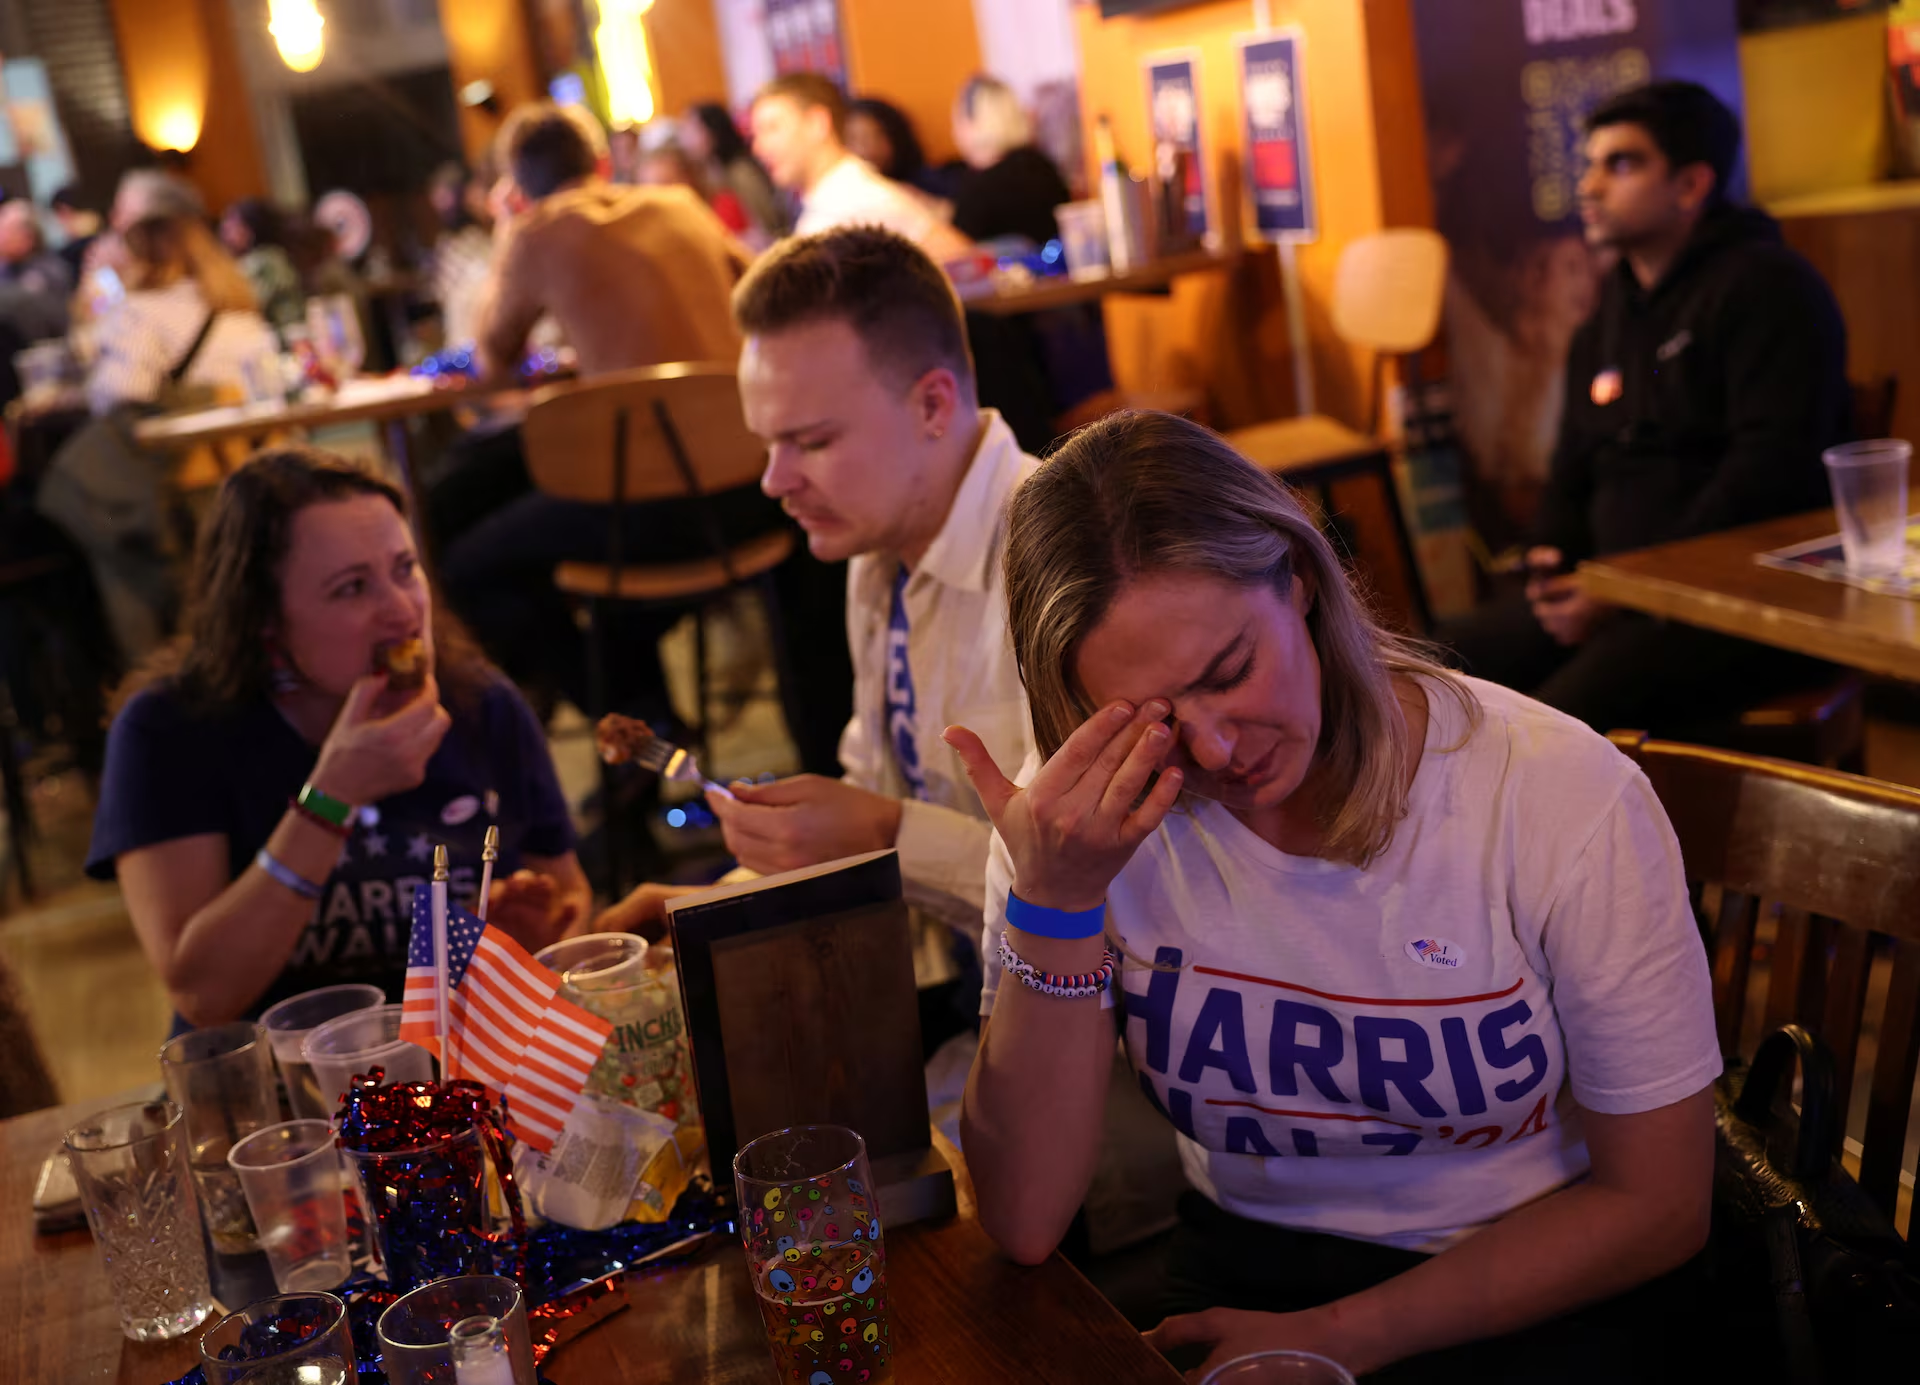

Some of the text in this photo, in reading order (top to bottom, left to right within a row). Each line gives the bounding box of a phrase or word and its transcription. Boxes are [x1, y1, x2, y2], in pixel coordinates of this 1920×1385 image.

[312, 867, 476, 925] ARRS
[1430, 953, 1458, 967] Voted
[1442, 945, 1448, 955] I
[1023, 976, 1097, 997] HOTTIES
[1117, 938, 1548, 1118] HARRIS
